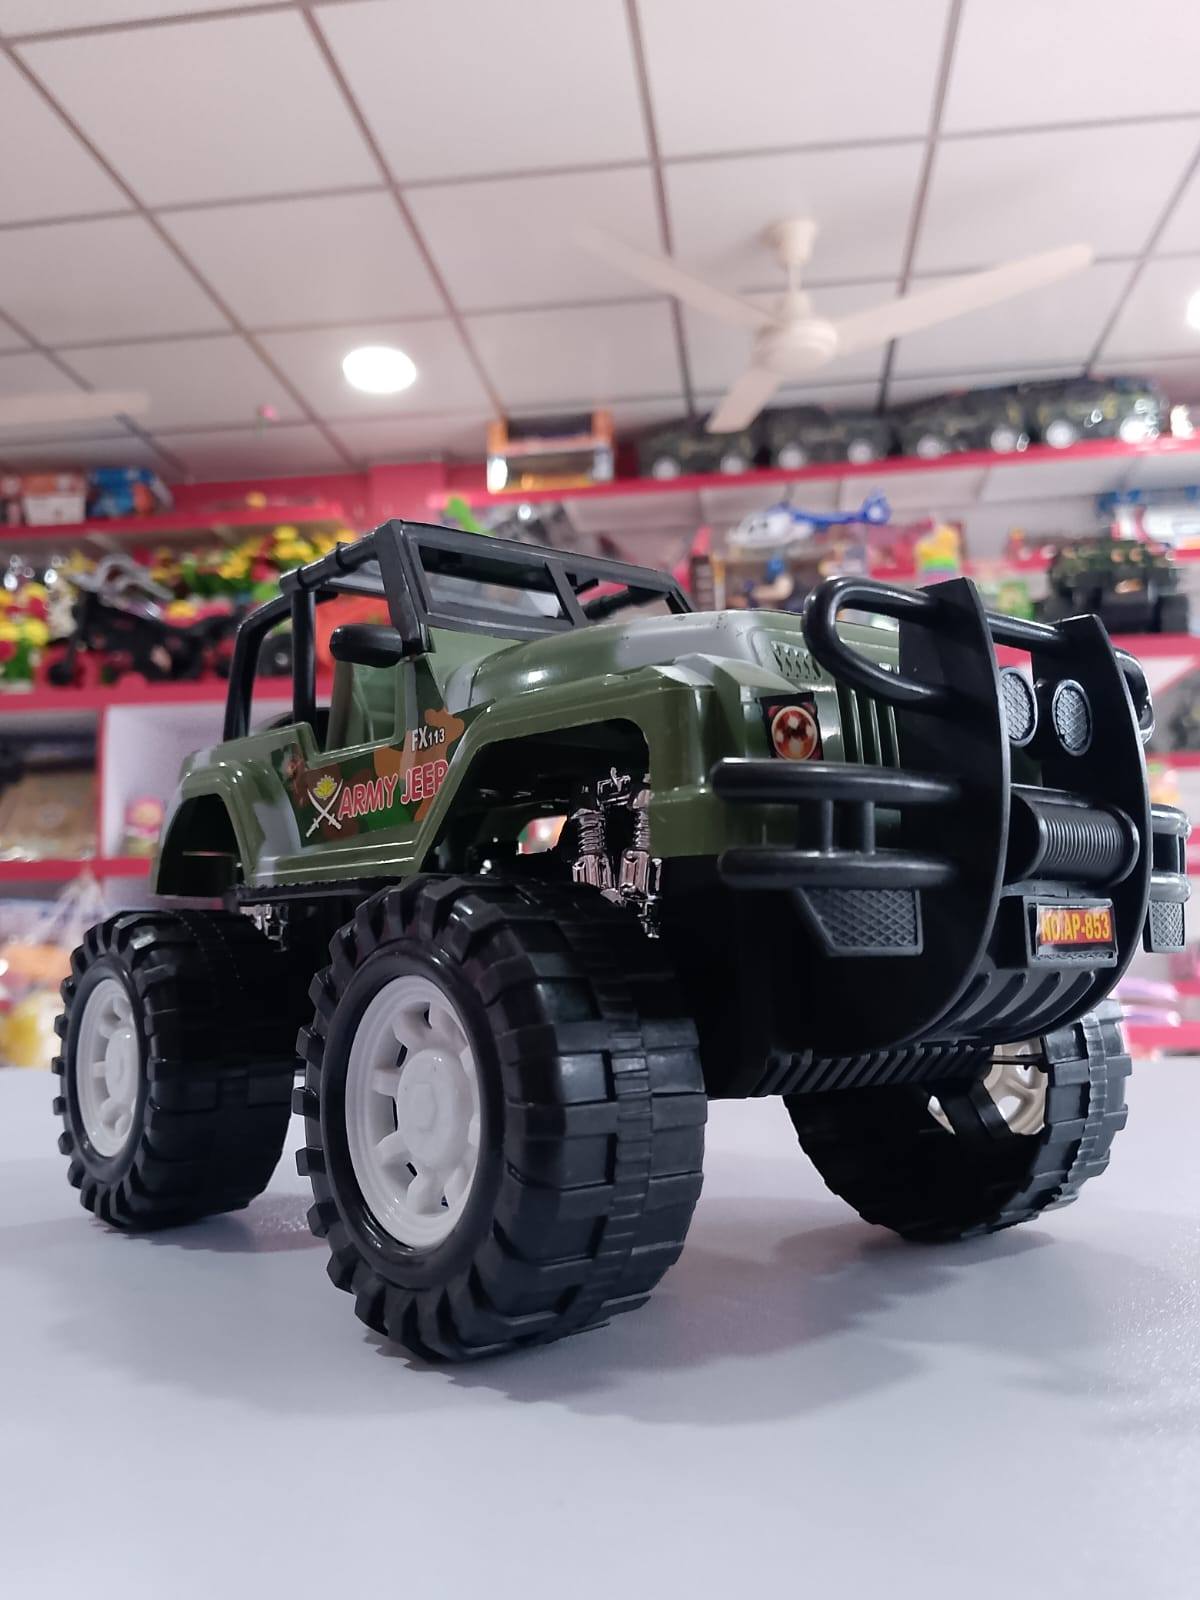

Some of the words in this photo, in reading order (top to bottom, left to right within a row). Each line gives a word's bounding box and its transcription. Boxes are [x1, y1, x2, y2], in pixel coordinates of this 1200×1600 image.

[411, 725, 446, 752] FX113
[338, 773, 399, 821] ARMY
[400, 759, 449, 805] JEEP
